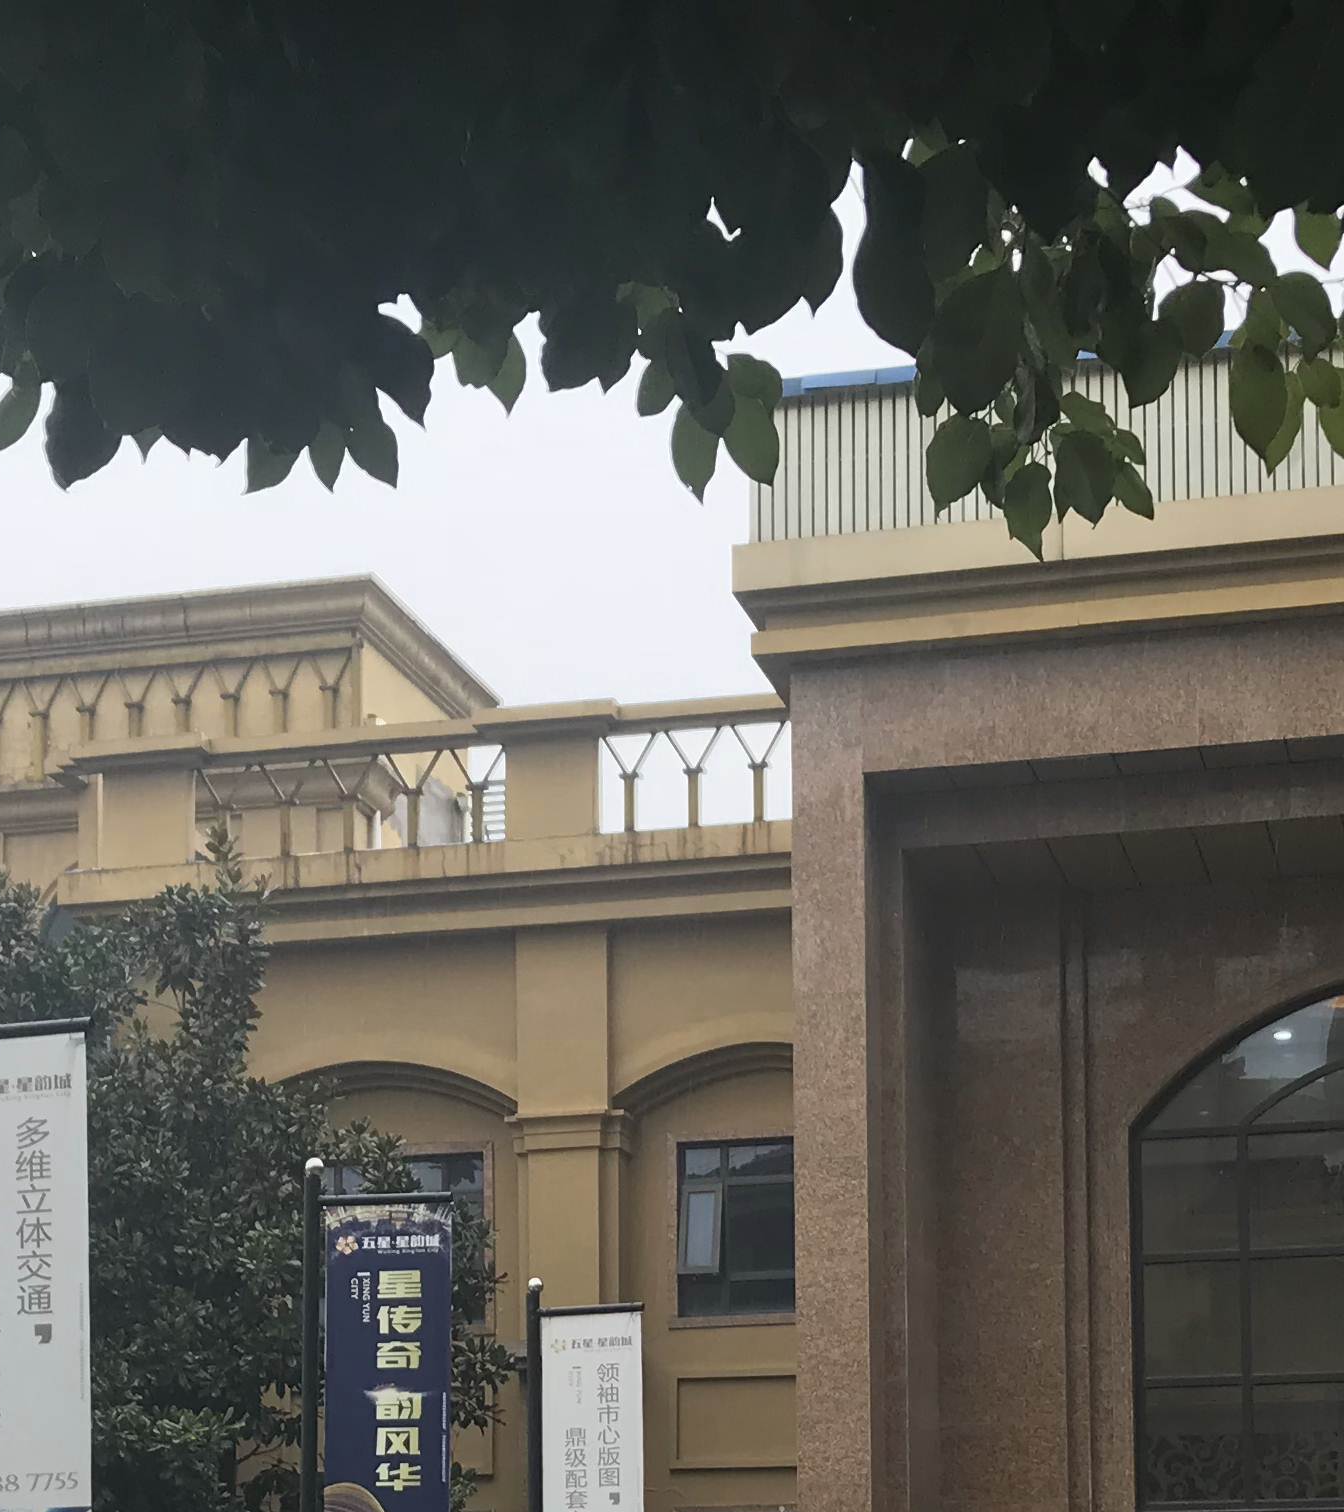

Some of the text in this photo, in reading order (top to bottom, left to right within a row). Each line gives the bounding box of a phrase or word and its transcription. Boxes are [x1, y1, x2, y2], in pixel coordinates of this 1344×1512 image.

[350, 1277, 359, 1300] CITY
[362, 1278, 371, 1323] XING YUN
[376, 1270, 423, 1369] 星传奇
[26, 1471, 79, 1493] 7755
